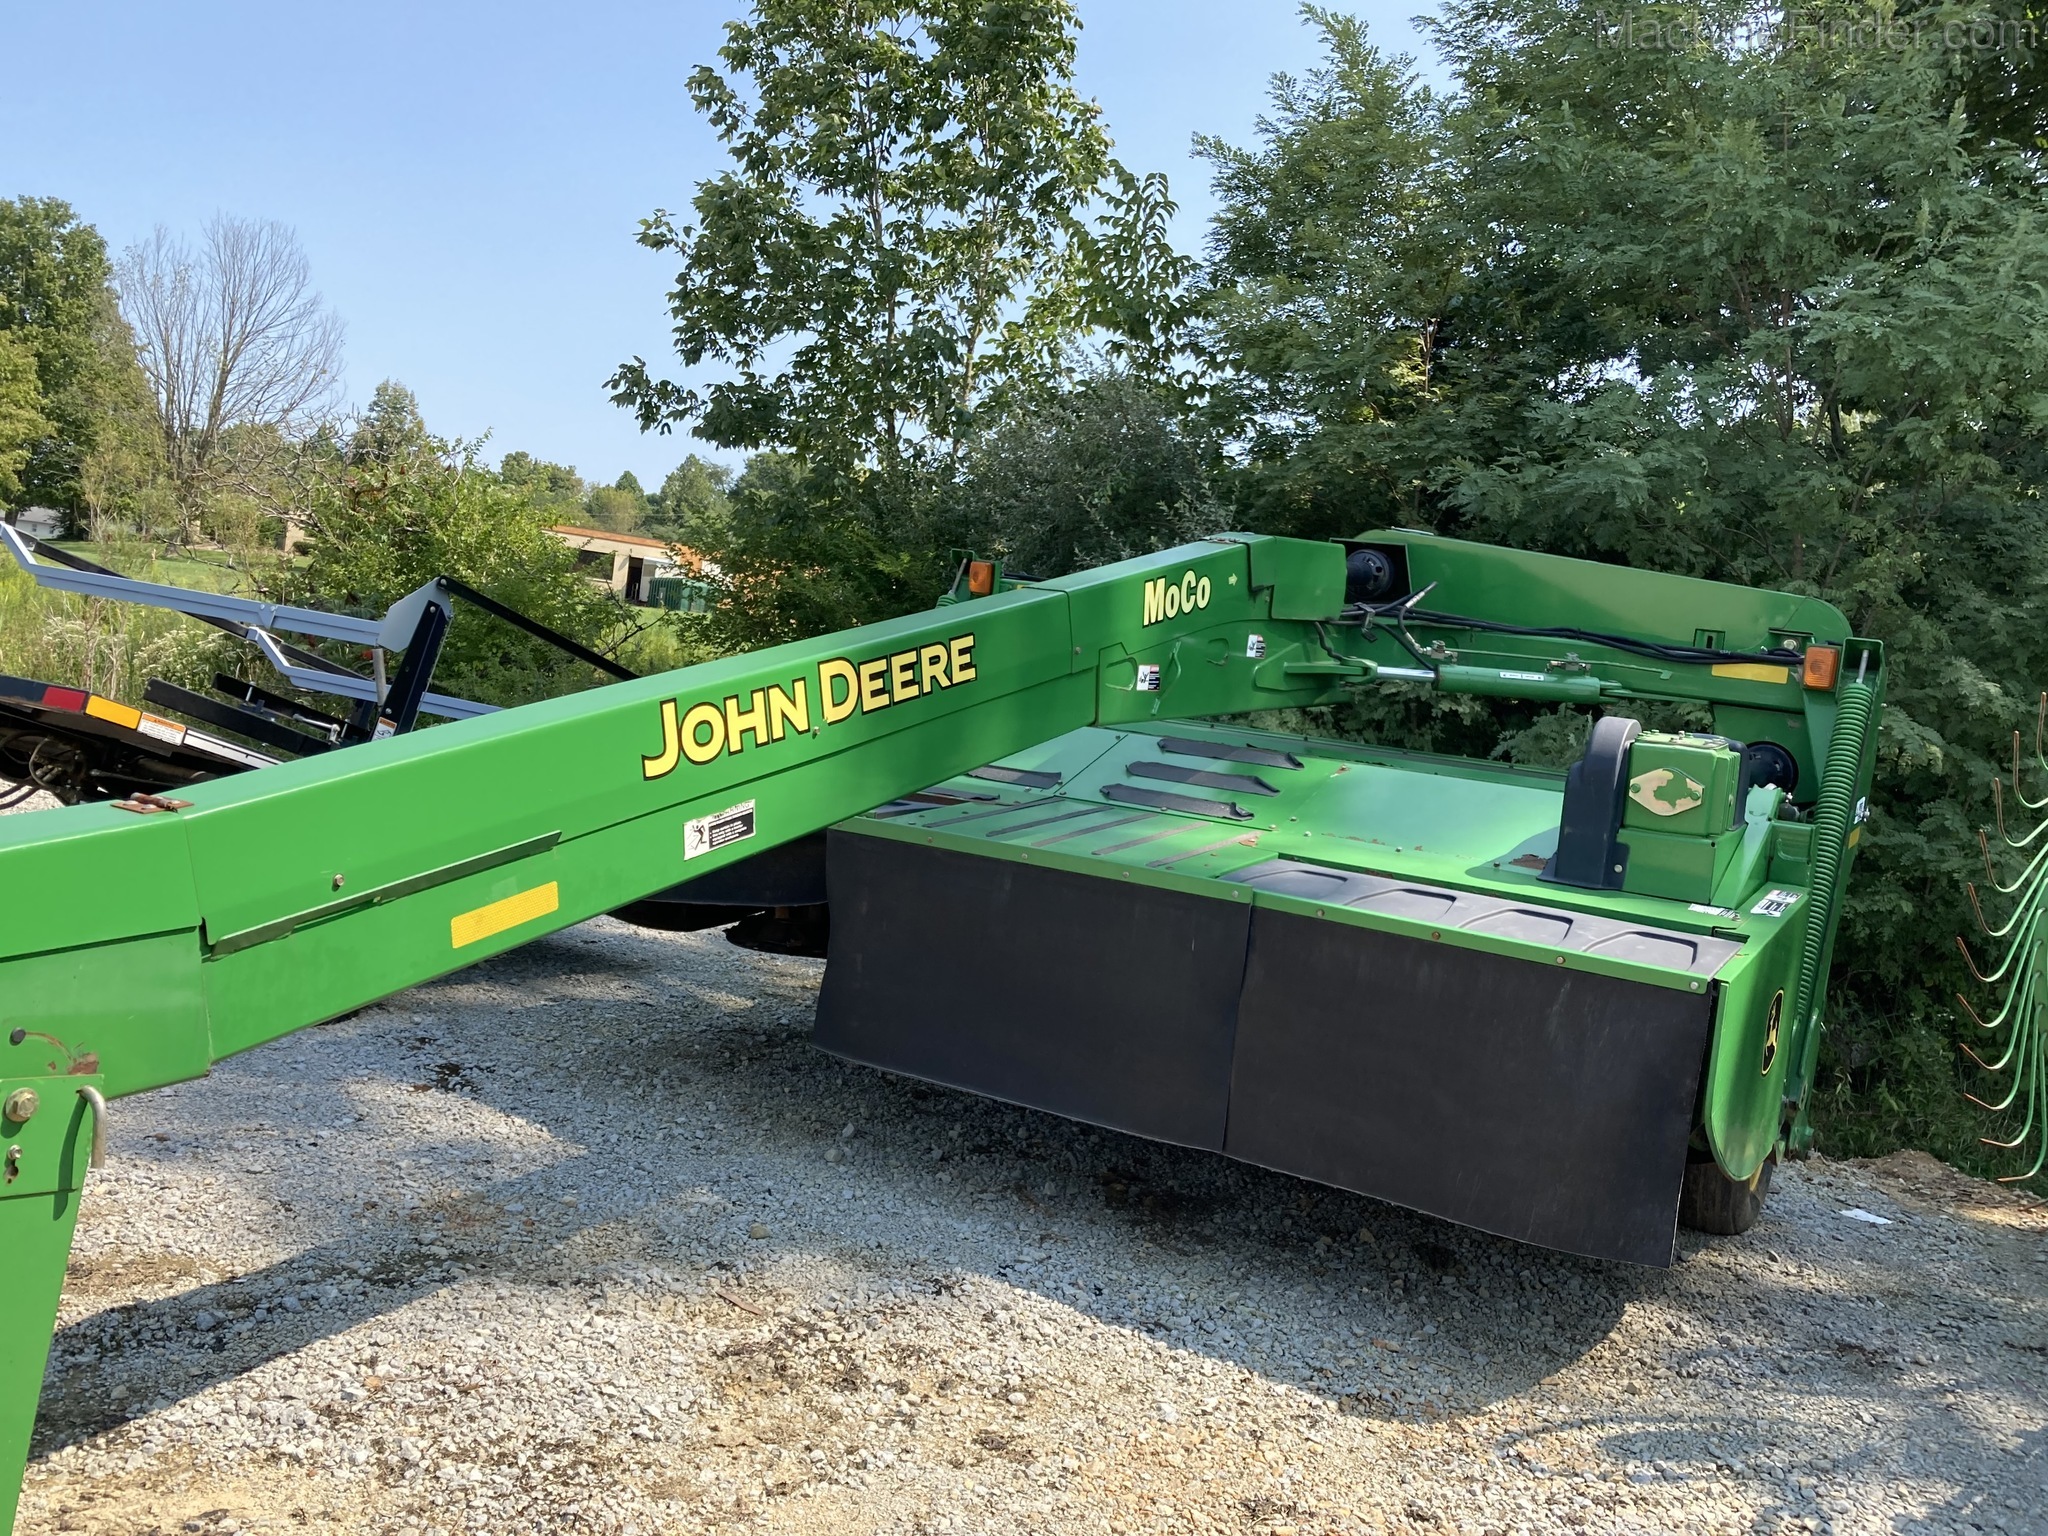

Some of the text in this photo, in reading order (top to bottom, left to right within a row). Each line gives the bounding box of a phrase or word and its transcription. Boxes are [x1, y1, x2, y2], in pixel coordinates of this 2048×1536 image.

[1142, 568, 1212, 629] MoCo
[641, 632, 977, 781] JOHN DEERE
